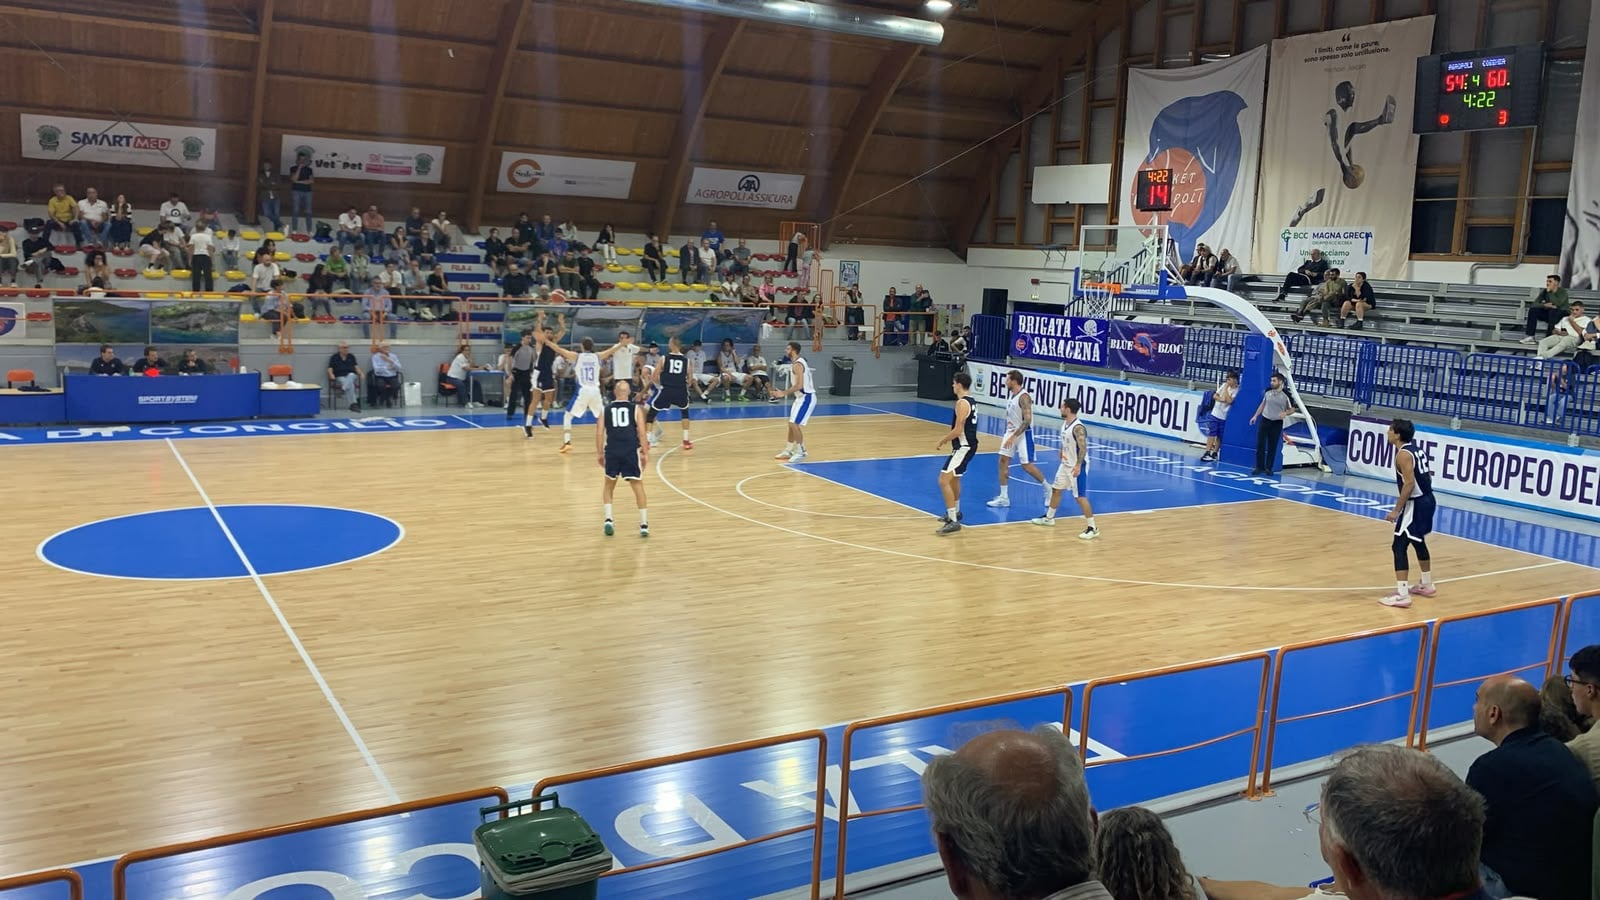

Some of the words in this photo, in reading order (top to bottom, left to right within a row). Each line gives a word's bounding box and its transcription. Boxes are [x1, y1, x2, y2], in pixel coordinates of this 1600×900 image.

[1320, 54, 1340, 62] spesso
[1341, 50, 1354, 58] solo
[1472, 74, 1481, 87] 4
[1463, 90, 1496, 108] 4:22
[1498, 109, 1507, 125] 3
[315, 159, 336, 169] Vet
[1147, 169, 1169, 183] 4:22
[694, 188, 746, 201] AGROPOLI
[747, 192, 793, 204] ASSICURA
[1149, 185, 1169, 206] 14
[1293, 232, 1309, 240] BCC
[1018, 314, 1072, 338] BRIGATA
[1032, 336, 1101, 363] SARACENA
[1110, 338, 1134, 351] BLUE
[584, 366, 595, 382] 13
[668, 358, 683, 375] 19
[610, 407, 630, 427] 10
[1076, 385, 1097, 415] AD
[1100, 388, 1190, 433] AGROPOLI
[139, 418, 447, 437] CONCILIO
[1414, 449, 1430, 474] 12
[1442, 443, 1554, 498] EUROPEO
[1559, 462, 1600, 507] DE
[1172, 465, 1398, 513] AGROPOL
